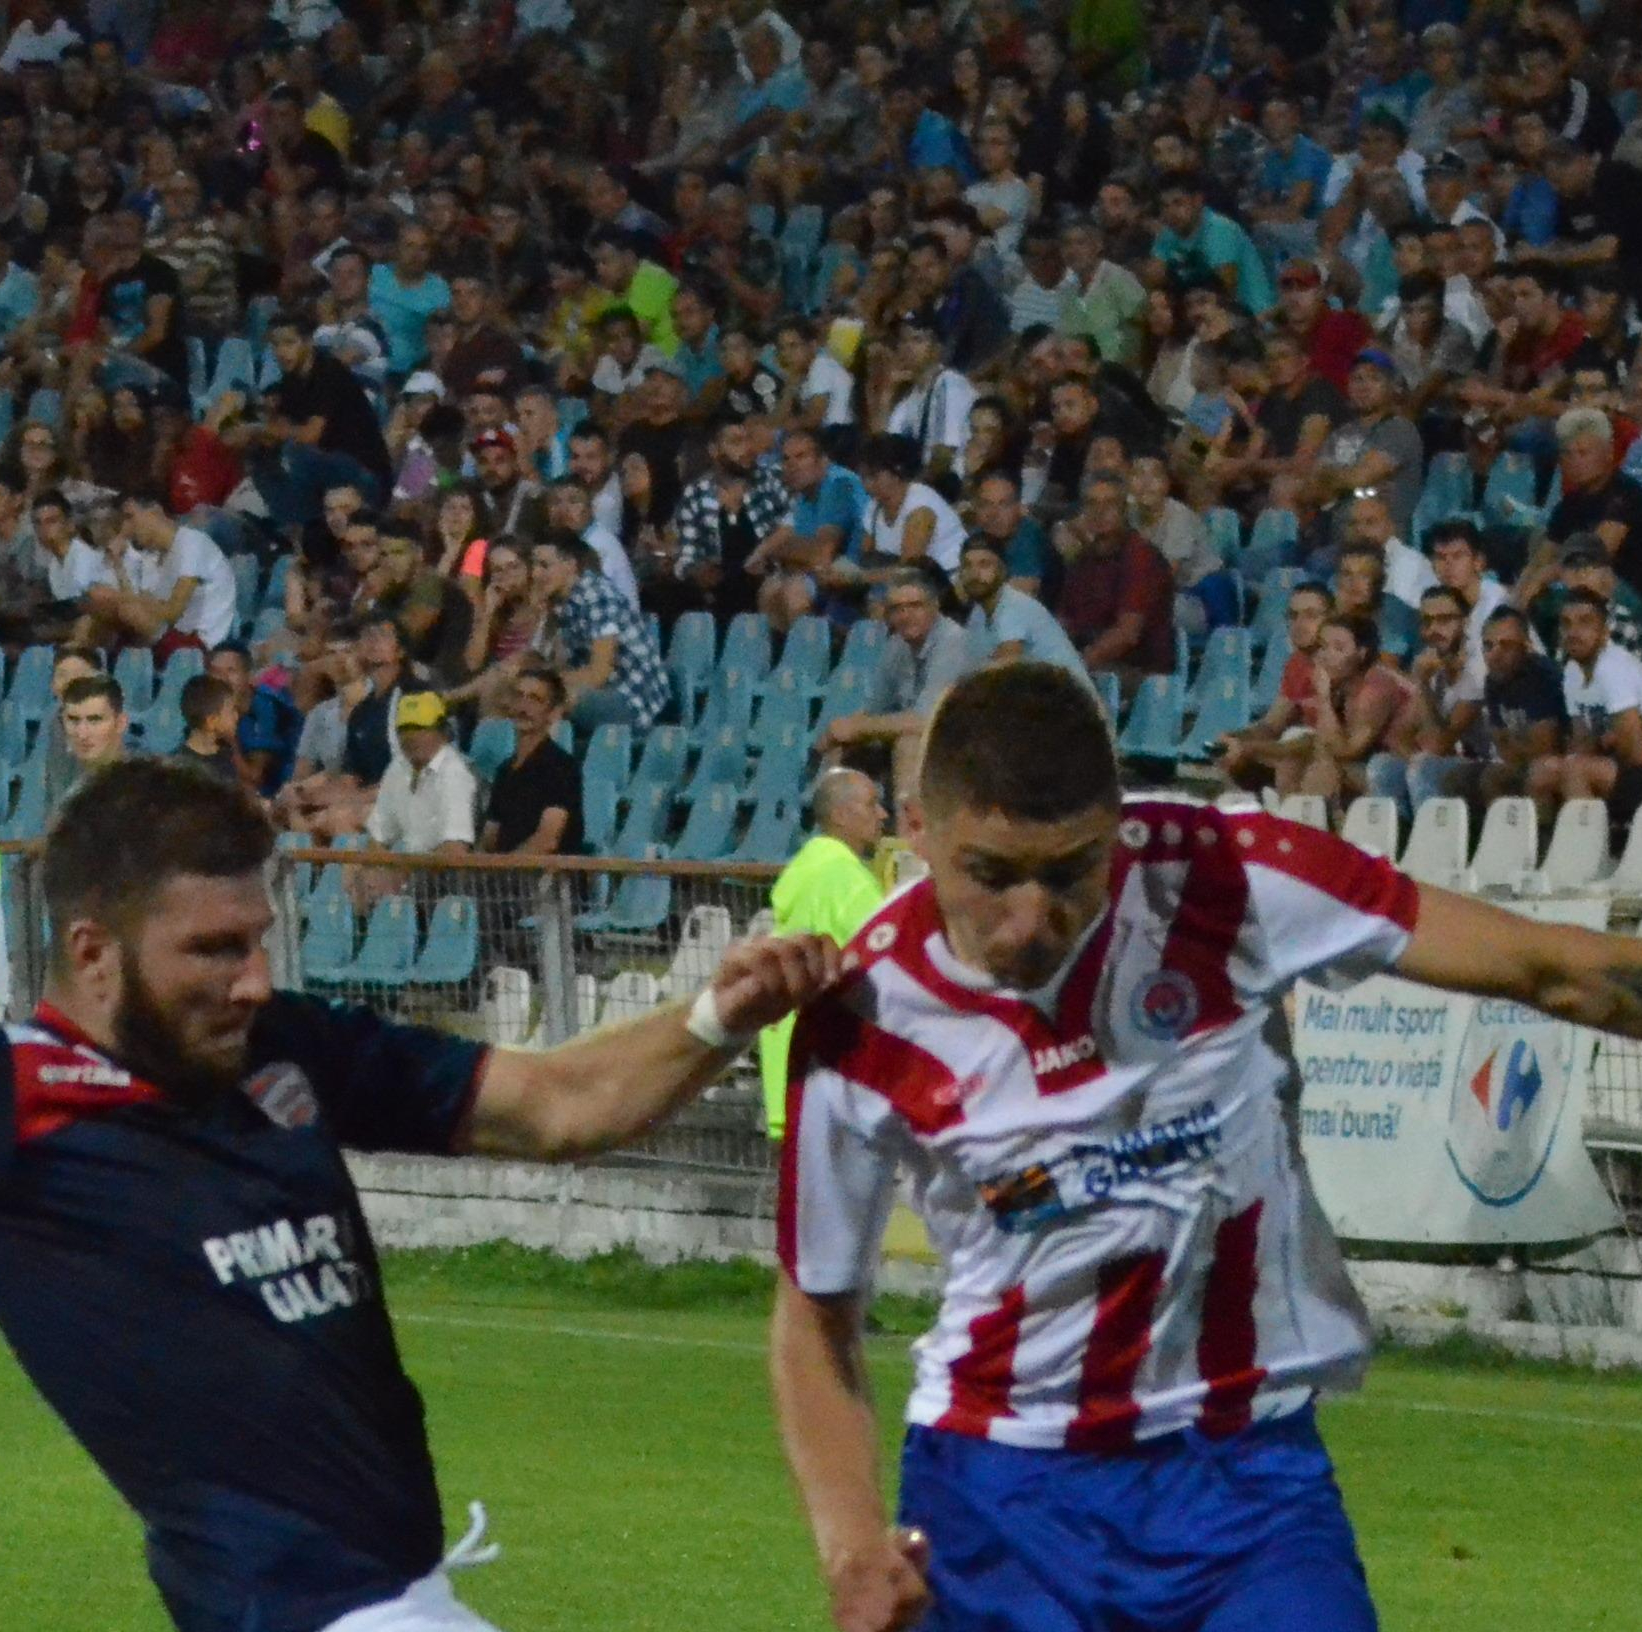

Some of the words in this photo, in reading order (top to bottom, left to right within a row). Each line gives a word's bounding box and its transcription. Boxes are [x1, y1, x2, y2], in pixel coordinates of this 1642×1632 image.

[1304, 994, 1342, 1029] Mai
[1346, 996, 1394, 1033] mult
[1395, 1002, 1447, 1043] sport
[1034, 1034, 1096, 1074] JAKO
[1377, 1059, 1393, 1087] o
[1300, 1100, 1337, 1136] mai
